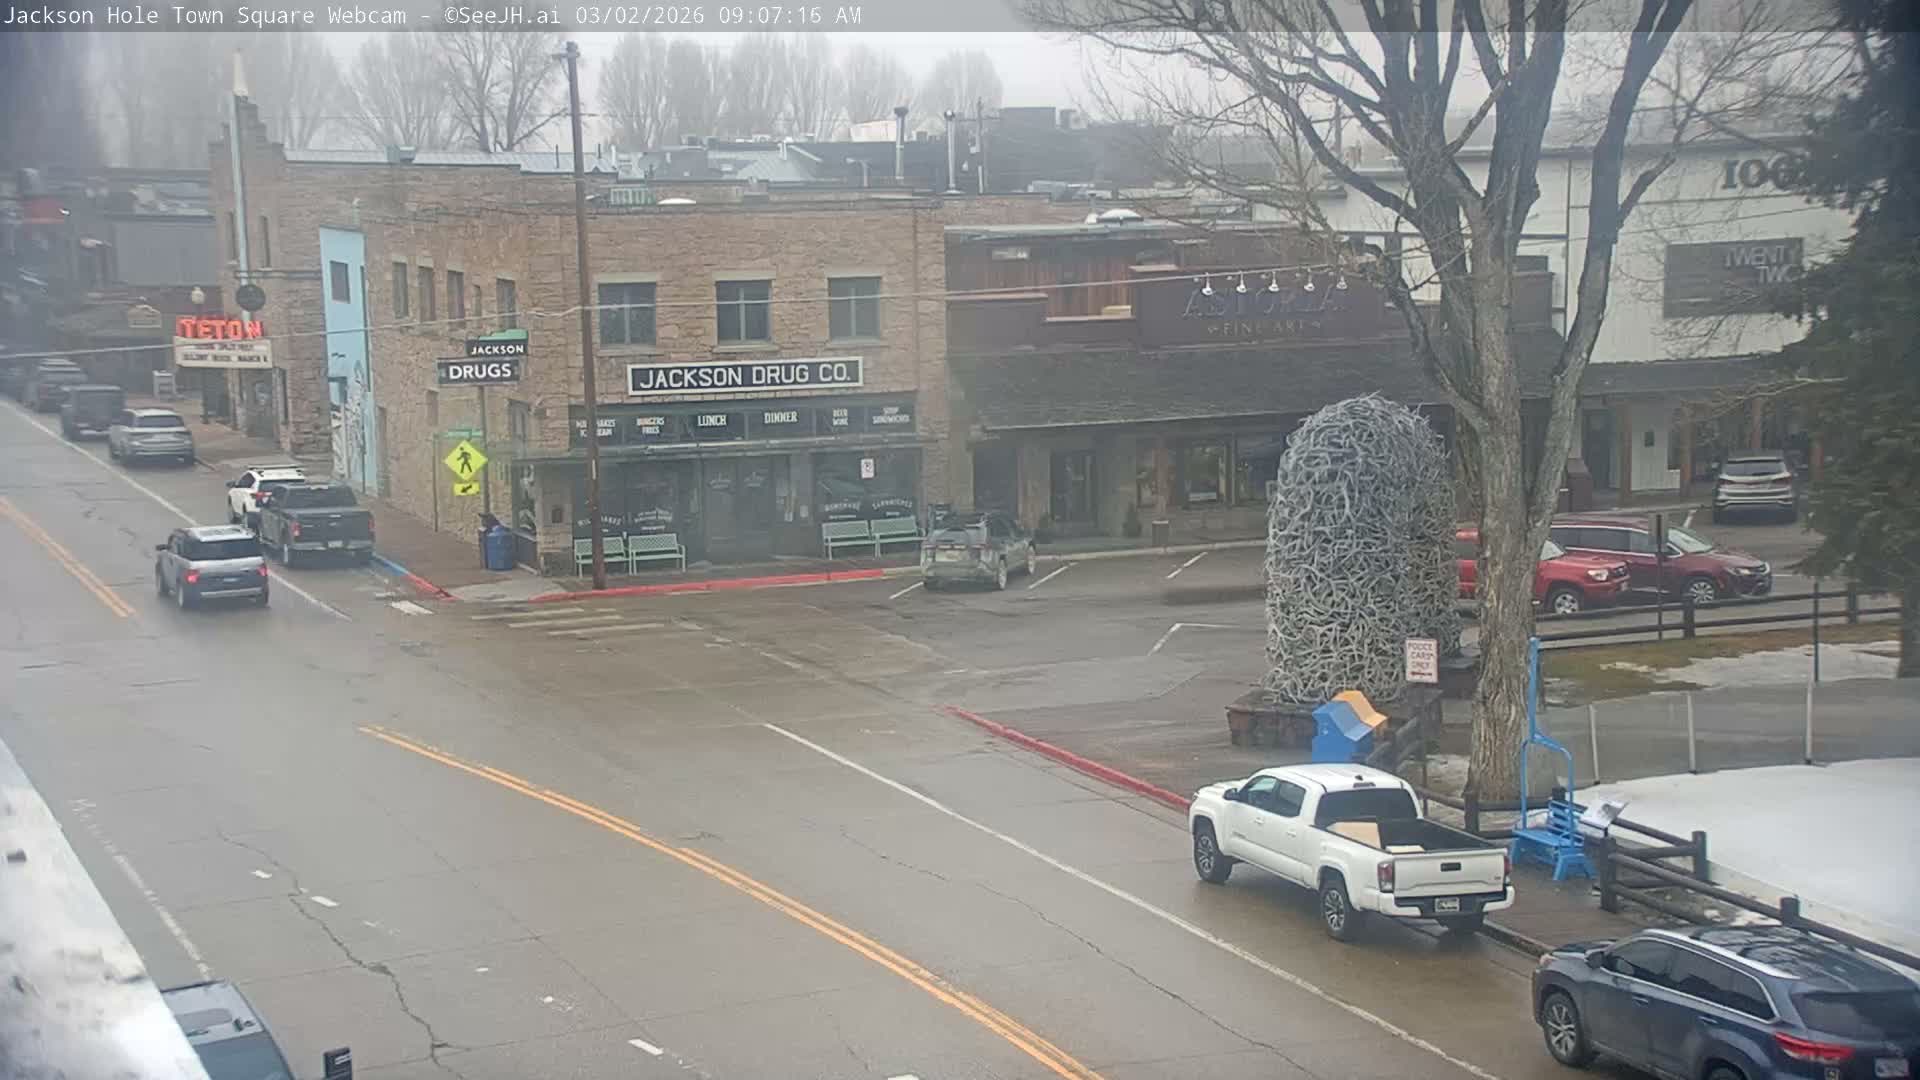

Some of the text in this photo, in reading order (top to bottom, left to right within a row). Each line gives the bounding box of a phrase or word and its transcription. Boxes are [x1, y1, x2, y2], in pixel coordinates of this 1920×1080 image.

[178, 318, 262, 340] TETON
[471, 345, 524, 355] JACKSON
[449, 363, 512, 380] DRUGS
[640, 363, 851, 389] JACKSON DRUG CO.
[697, 414, 728, 427] LUNCH
[764, 411, 798, 424] DINNER
